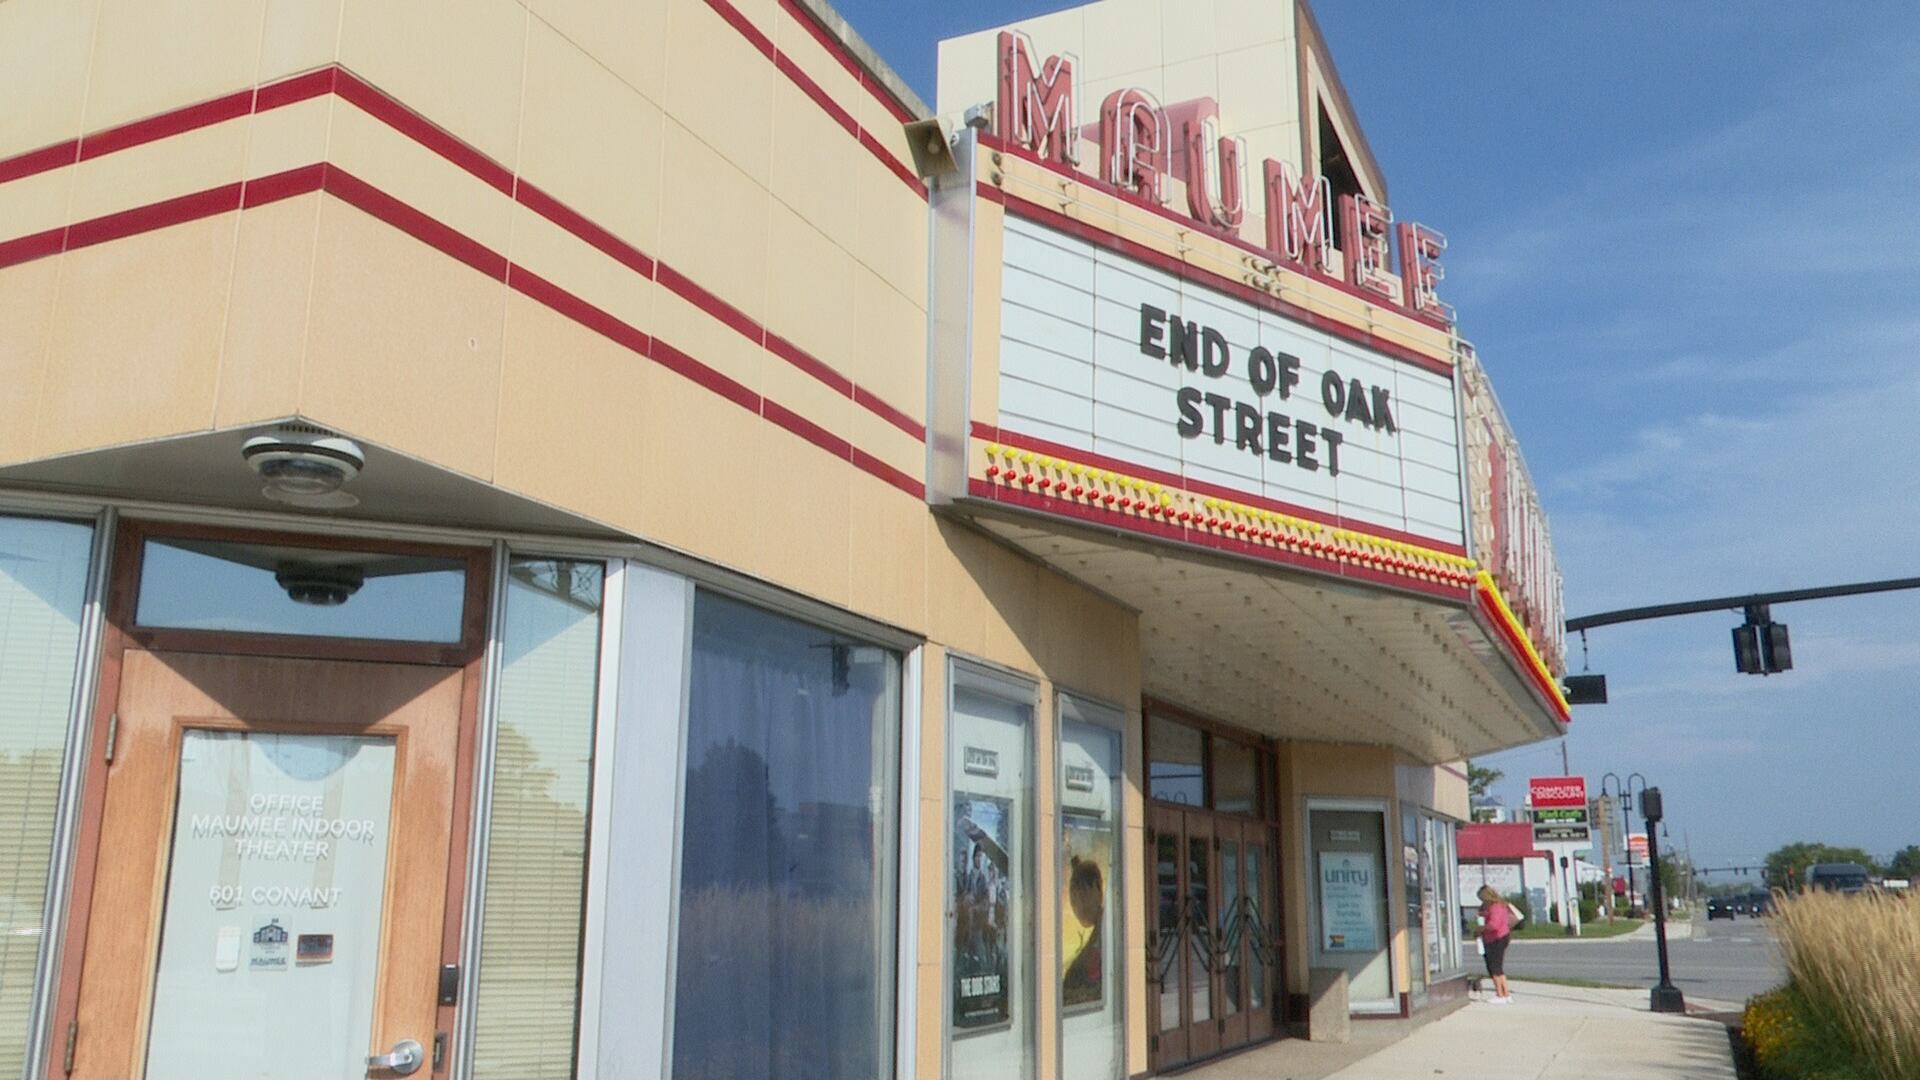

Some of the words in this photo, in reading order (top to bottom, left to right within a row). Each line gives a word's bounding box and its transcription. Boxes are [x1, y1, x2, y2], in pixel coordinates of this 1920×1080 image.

[997, 29, 1456, 322] MAUMEE
[1141, 303, 1230, 379] END
[1248, 346, 1300, 400] OF
[1321, 369, 1396, 436] OAK
[1177, 386, 1343, 477] STREET
[250, 793, 324, 812] OFFICE
[191, 814, 286, 834] MAUMEE
[292, 816, 375, 835] INDOOR
[235, 838, 329, 858] THEATER
[1325, 868, 1368, 887] unity
[209, 885, 243, 902] 601
[251, 885, 342, 902] CONANT
